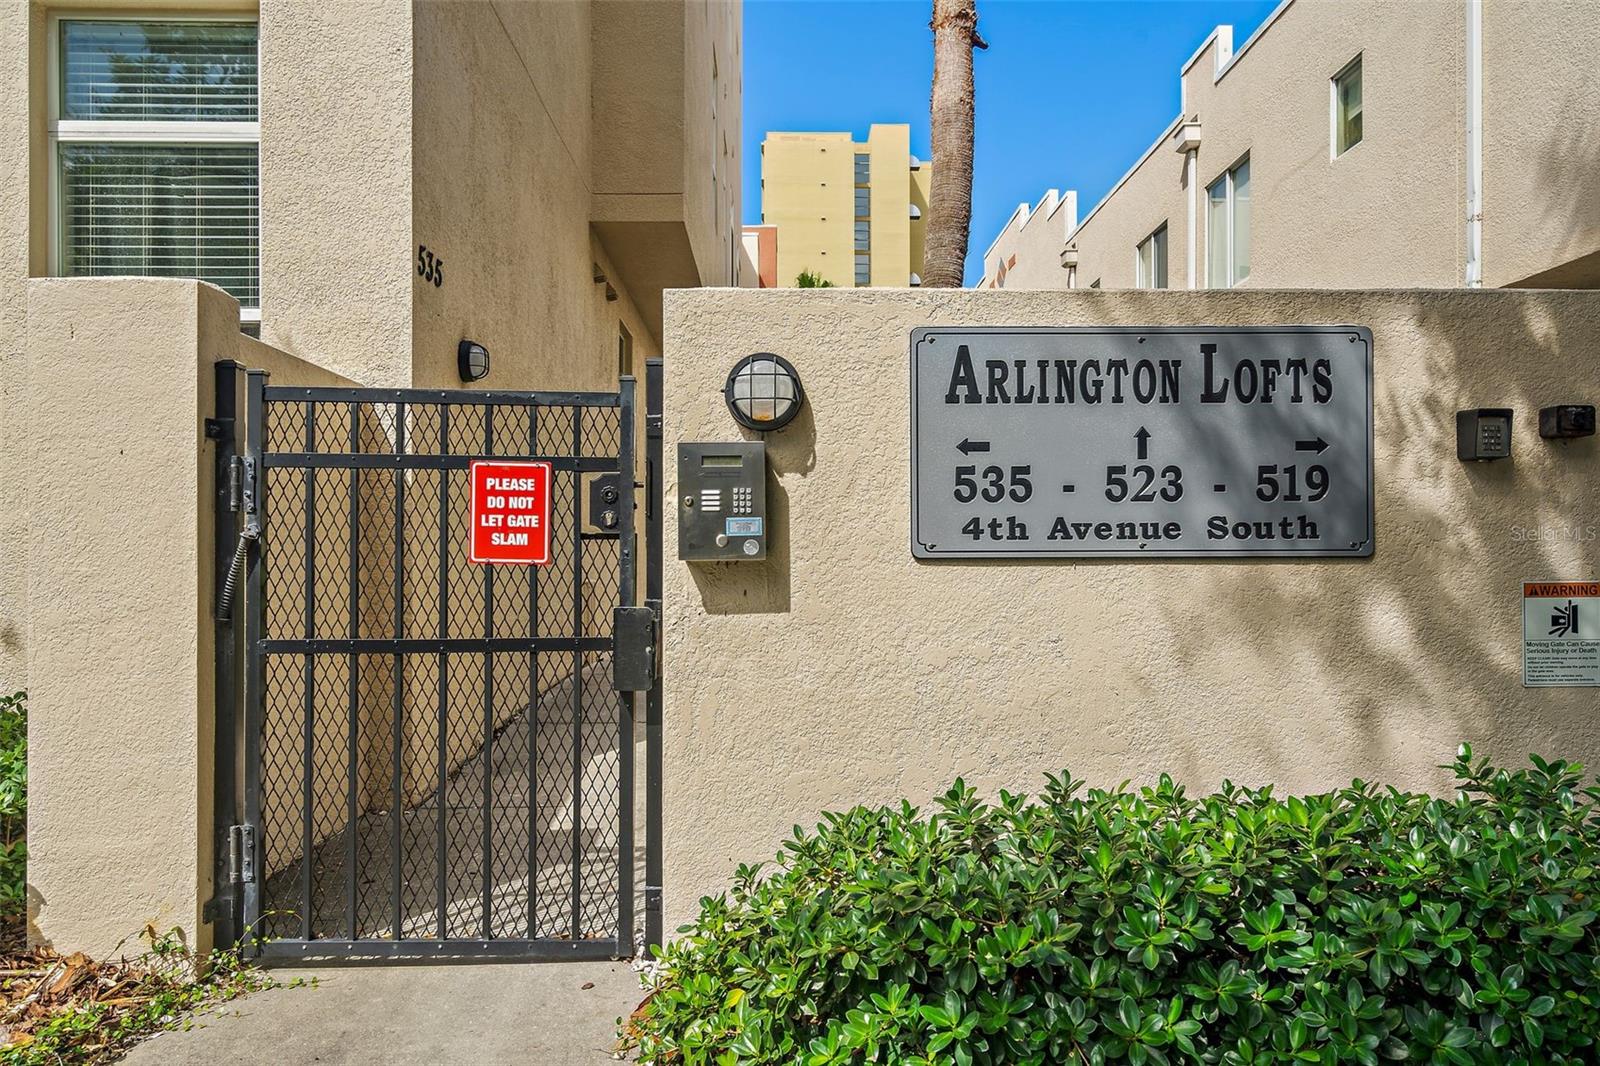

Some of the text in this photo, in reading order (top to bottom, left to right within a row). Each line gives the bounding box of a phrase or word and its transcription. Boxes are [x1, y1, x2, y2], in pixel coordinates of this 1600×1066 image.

[418, 244, 443, 288] 535
[945, 343, 1333, 404] ARLINGTON LOFTS
[486, 478, 536, 491] PLEASE
[953, 465, 1033, 503] 535
[1105, 465, 1184, 502] 523
[1256, 464, 1330, 502] 519
[487, 496, 534, 509] DO NOT
[481, 514, 539, 528] LET GATE
[961, 515, 1320, 541] 4th Avenue South
[491, 532, 528, 546] SLAM
[1540, 585, 1598, 596] WARNING
